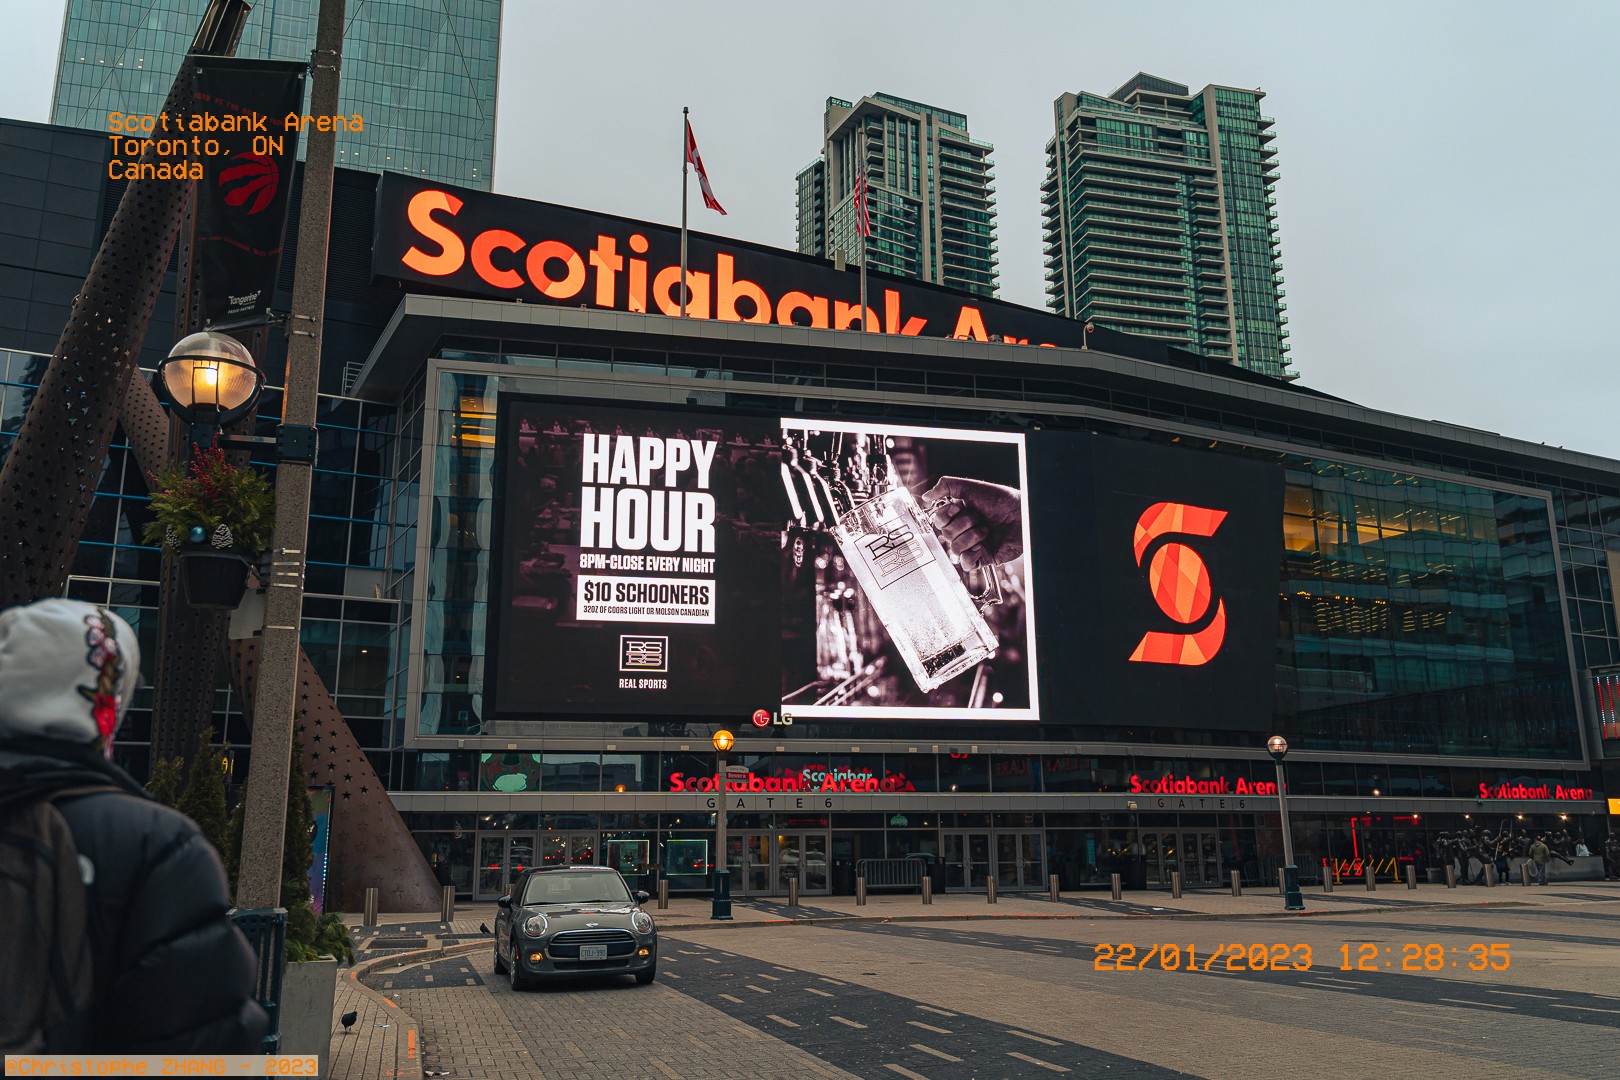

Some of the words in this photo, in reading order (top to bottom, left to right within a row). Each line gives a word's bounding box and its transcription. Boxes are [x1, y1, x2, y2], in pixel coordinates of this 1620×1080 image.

[402, 190, 927, 338] Scotiabank
[582, 433, 717, 489] HAPPY
[580, 486, 716, 553] HOUR
[580, 553, 644, 571] 8PM-CLOSE
[646, 556, 680, 572] EVERY
[682, 557, 716, 573] NIGHT
[584, 580, 611, 603] $10
[616, 582, 709, 606] SCHOONERS
[600, 606, 608, 614] OF
[608, 606, 628, 615] COORS
[629, 607, 645, 616] LIGHT
[647, 607, 655, 616] OR
[655, 607, 679, 617] MOLSON
[680, 608, 710, 617] CANADIAN
[619, 679, 637, 689] REAL
[639, 679, 667, 690] SPORTS
[773, 712, 793, 726] LG
[820, 773, 896, 793] Arena
[1130, 774, 1230, 795] Scotiabank
[1479, 782, 1551, 800] Scotiabank
[1556, 784, 1593, 801] Arena
[825, 798, 833, 809] 6
[1239, 799, 1245, 809] 6
